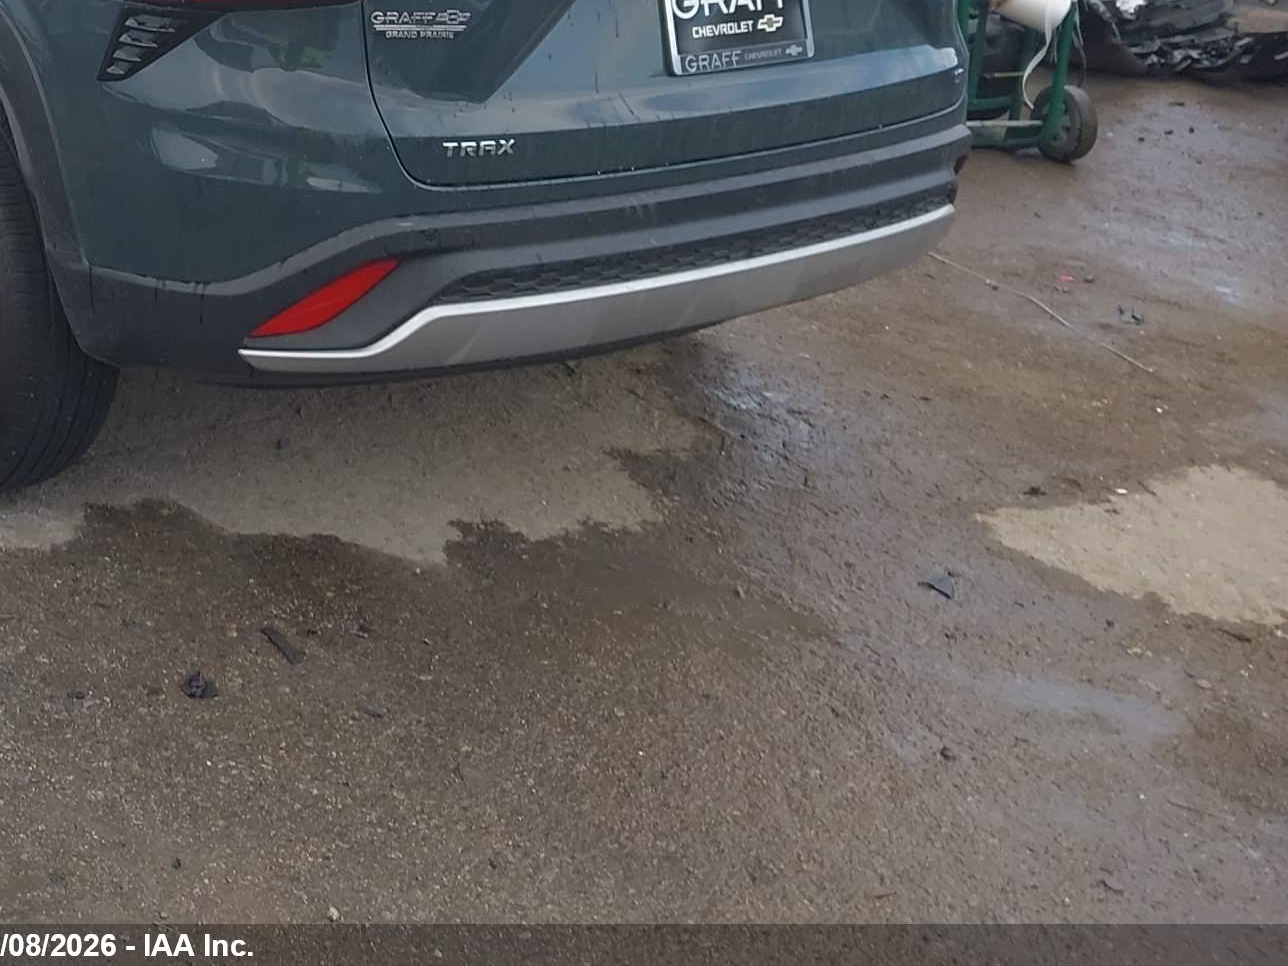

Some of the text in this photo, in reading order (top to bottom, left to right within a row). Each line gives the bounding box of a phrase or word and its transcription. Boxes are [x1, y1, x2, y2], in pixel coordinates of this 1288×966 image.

[371, 11, 436, 24] GRAFF
[385, 30, 455, 39] GRAND PRAIRIE
[692, 20, 754, 38] CHEVROLET
[685, 50, 742, 73] GRAFF
[442, 138, 515, 157] TRAX
